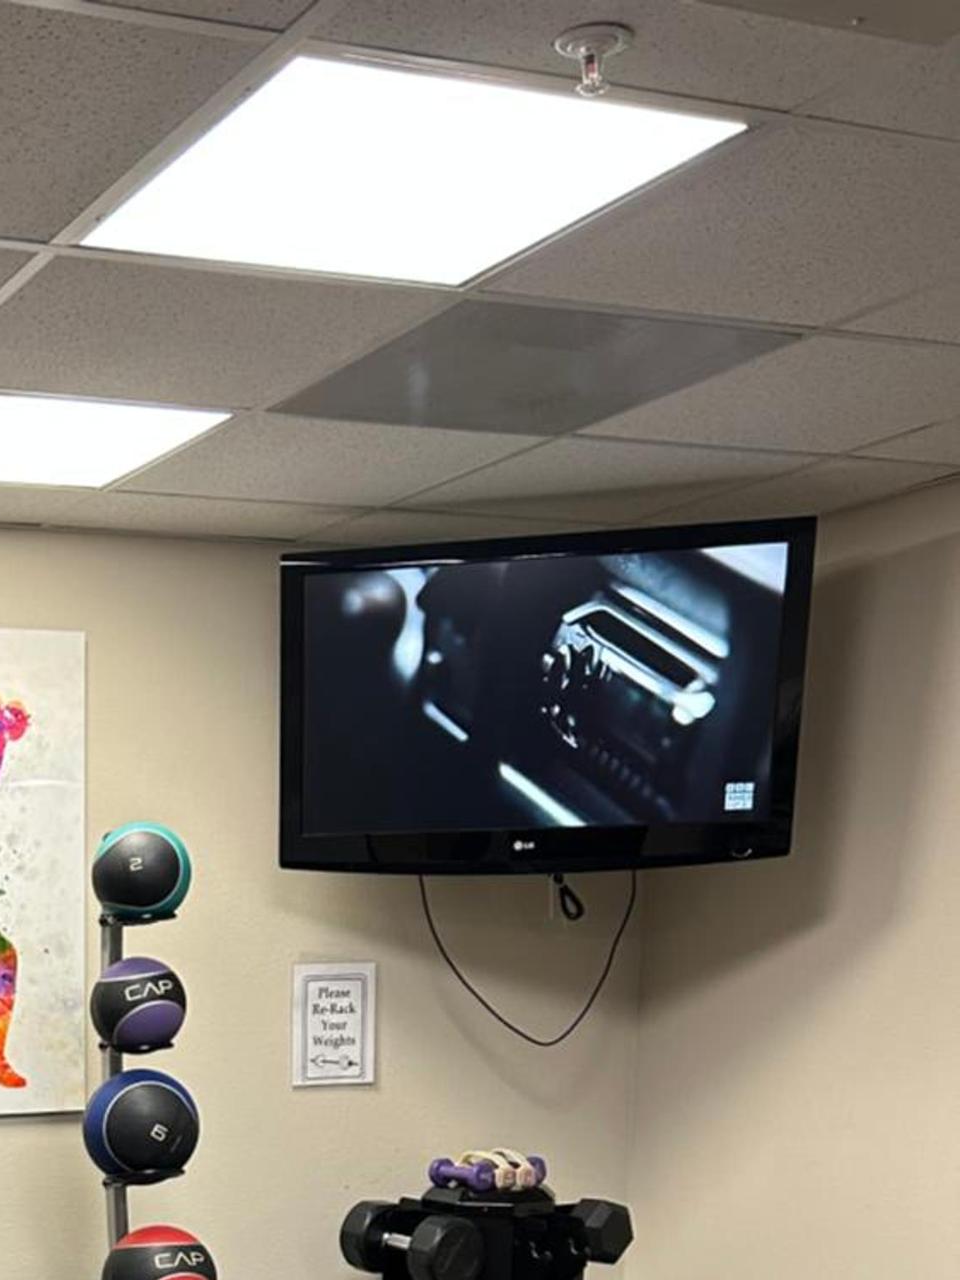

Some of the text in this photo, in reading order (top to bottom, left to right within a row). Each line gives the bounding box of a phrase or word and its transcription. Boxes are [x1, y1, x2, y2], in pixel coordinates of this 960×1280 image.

[129, 858, 143, 870] 2
[125, 980, 172, 1001] CAP
[318, 987, 351, 999] Please
[312, 1003, 356, 1014] Re-Rack
[321, 1019, 347, 1031] Your
[313, 1035, 355, 1049] Weights
[150, 1124, 168, 1141] 6
[155, 1252, 204, 1269] CAP
